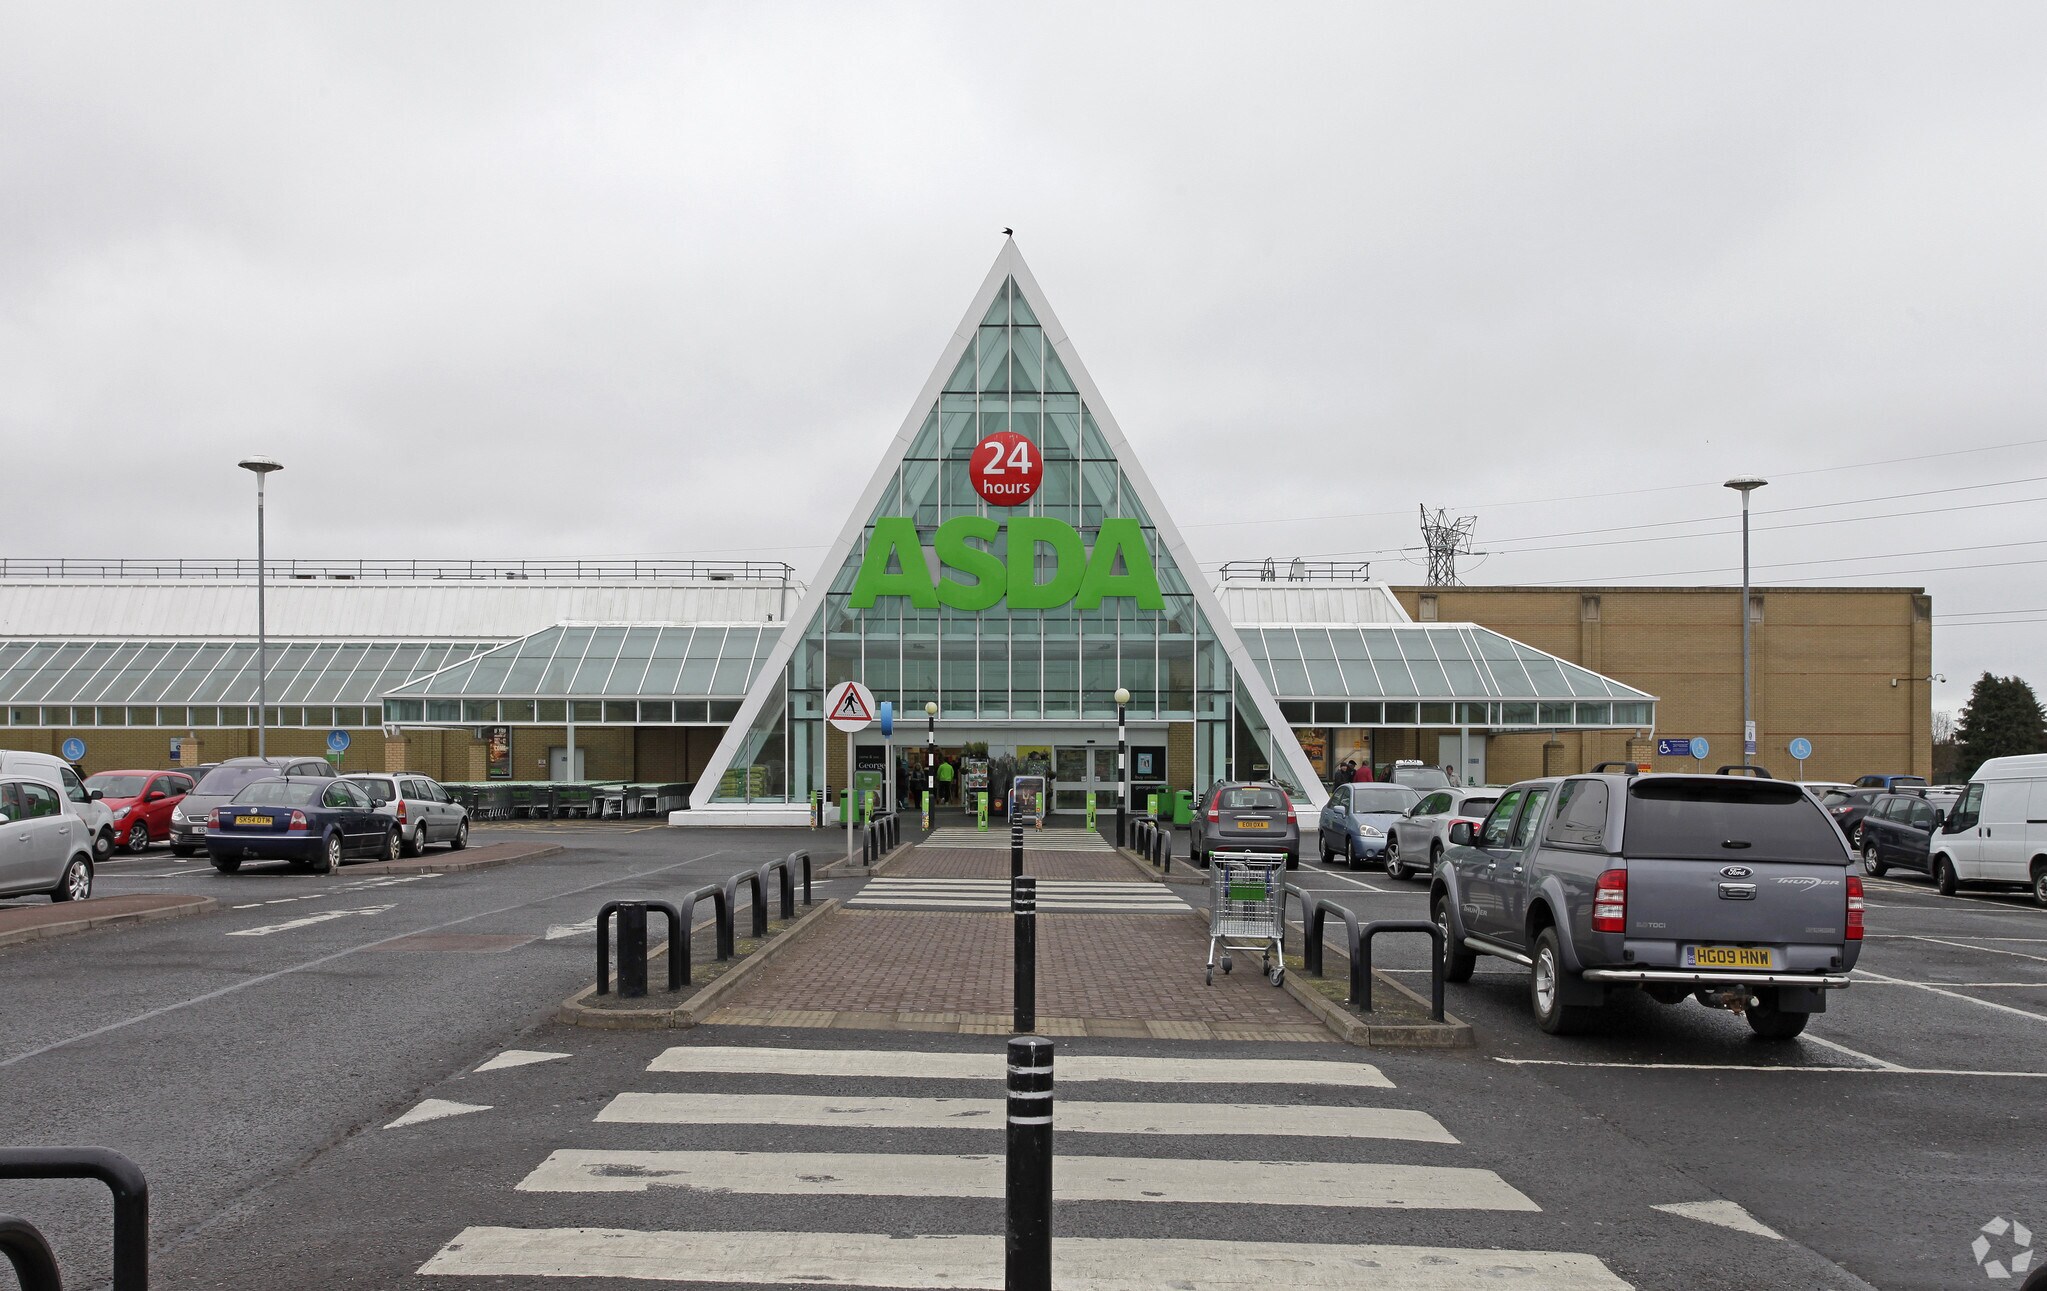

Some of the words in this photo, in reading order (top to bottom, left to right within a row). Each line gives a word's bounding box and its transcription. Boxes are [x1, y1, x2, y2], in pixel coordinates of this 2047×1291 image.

[983, 441, 1033, 475] 24
[983, 479, 1031, 494] hours
[848, 516, 1166, 611] ASDA
[858, 762, 886, 770] George
[1727, 868, 1746, 876] Ford
[1697, 949, 1736, 964] HG09
[1740, 951, 1769, 965] HNW
